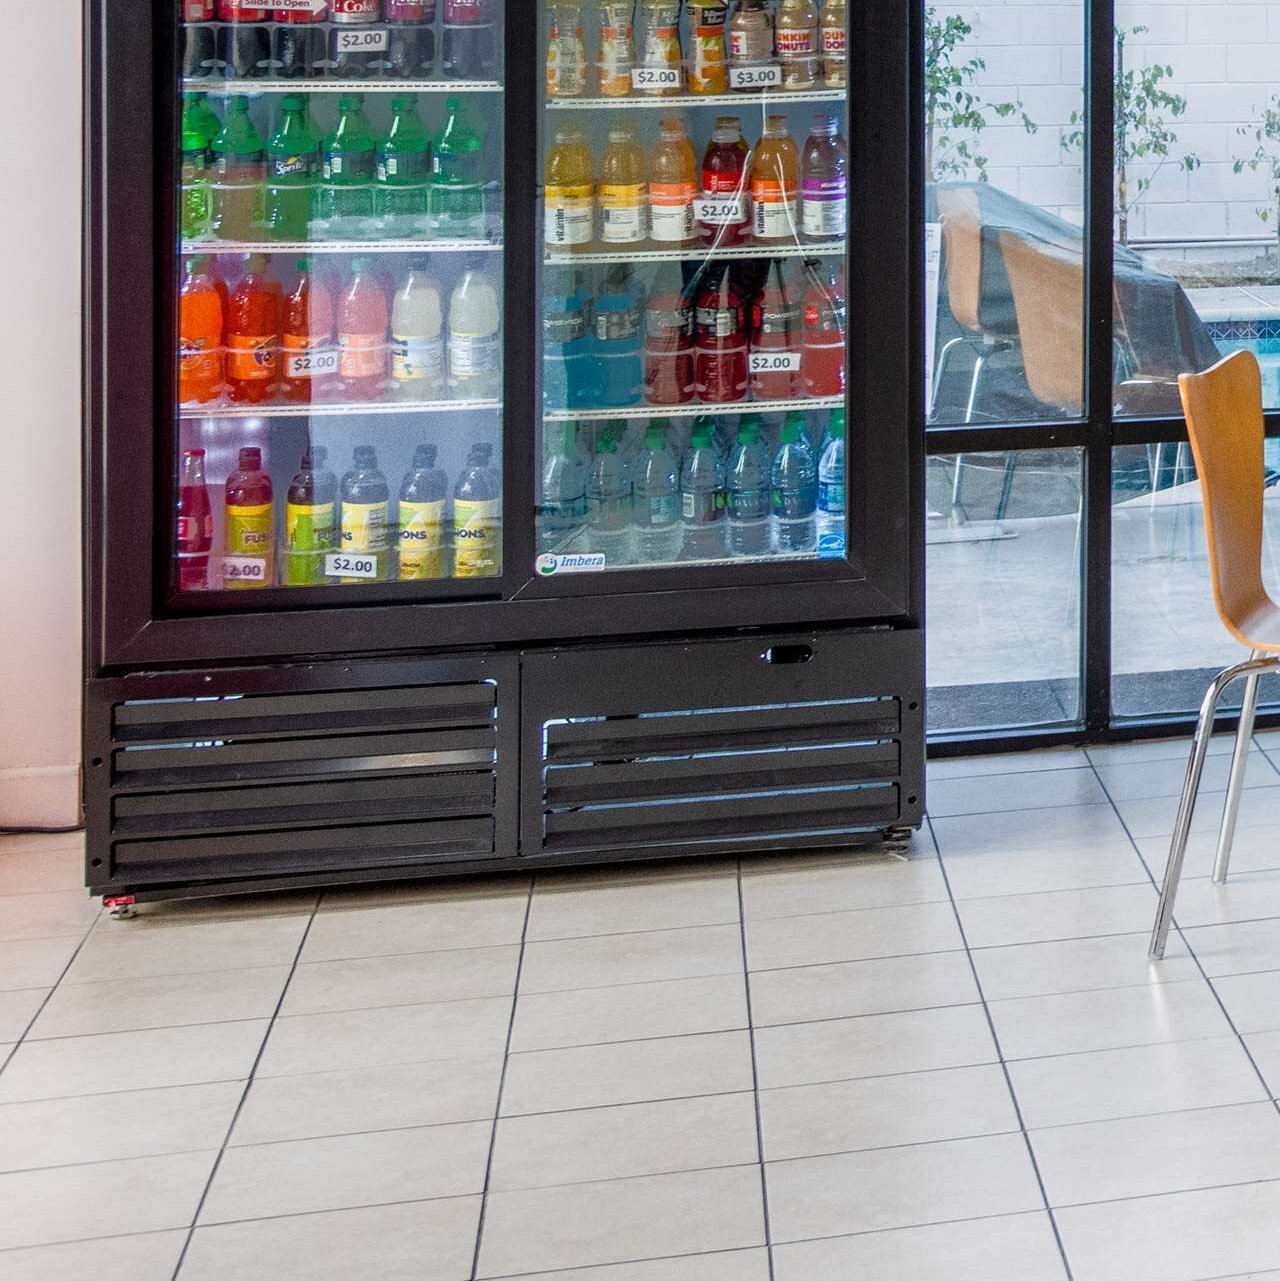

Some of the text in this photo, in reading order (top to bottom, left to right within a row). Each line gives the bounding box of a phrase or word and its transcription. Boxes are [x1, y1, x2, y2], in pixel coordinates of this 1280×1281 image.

[283, 0, 310, 8] Open
[342, 32, 382, 48] $2.00
[638, 71, 677, 84] $2.00
[737, 71, 776, 85] $3.00
[276, 160, 305, 176] Sprite
[701, 205, 739, 217] $2.00
[757, 202, 765, 234] vitamin
[294, 355, 335, 372] $2.00
[752, 357, 790, 370] $2.00
[334, 558, 373, 573] $2.00
